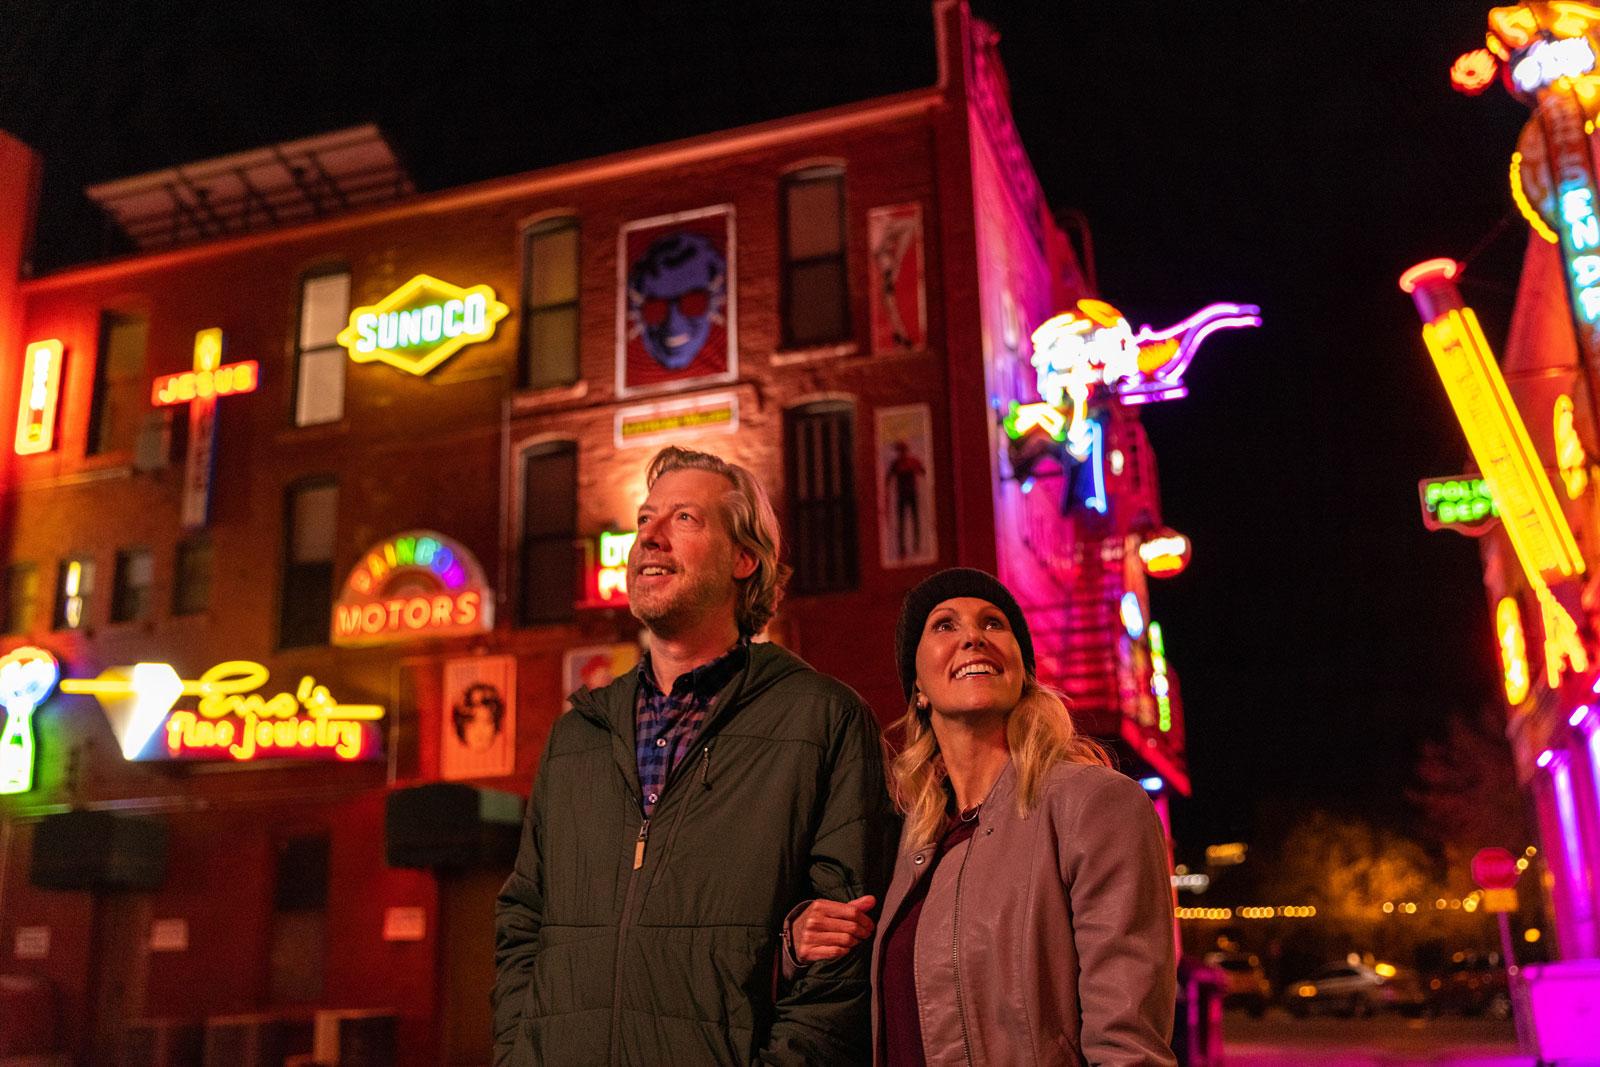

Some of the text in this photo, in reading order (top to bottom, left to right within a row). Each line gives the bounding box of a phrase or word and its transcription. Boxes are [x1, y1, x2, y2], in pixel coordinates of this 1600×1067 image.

[356, 292, 486, 353] SUNOCO
[158, 364, 252, 403] JESUS
[1425, 478, 1494, 505] POLIC
[350, 536, 467, 594] RAINBOW
[335, 591, 481, 636] MOTORS
